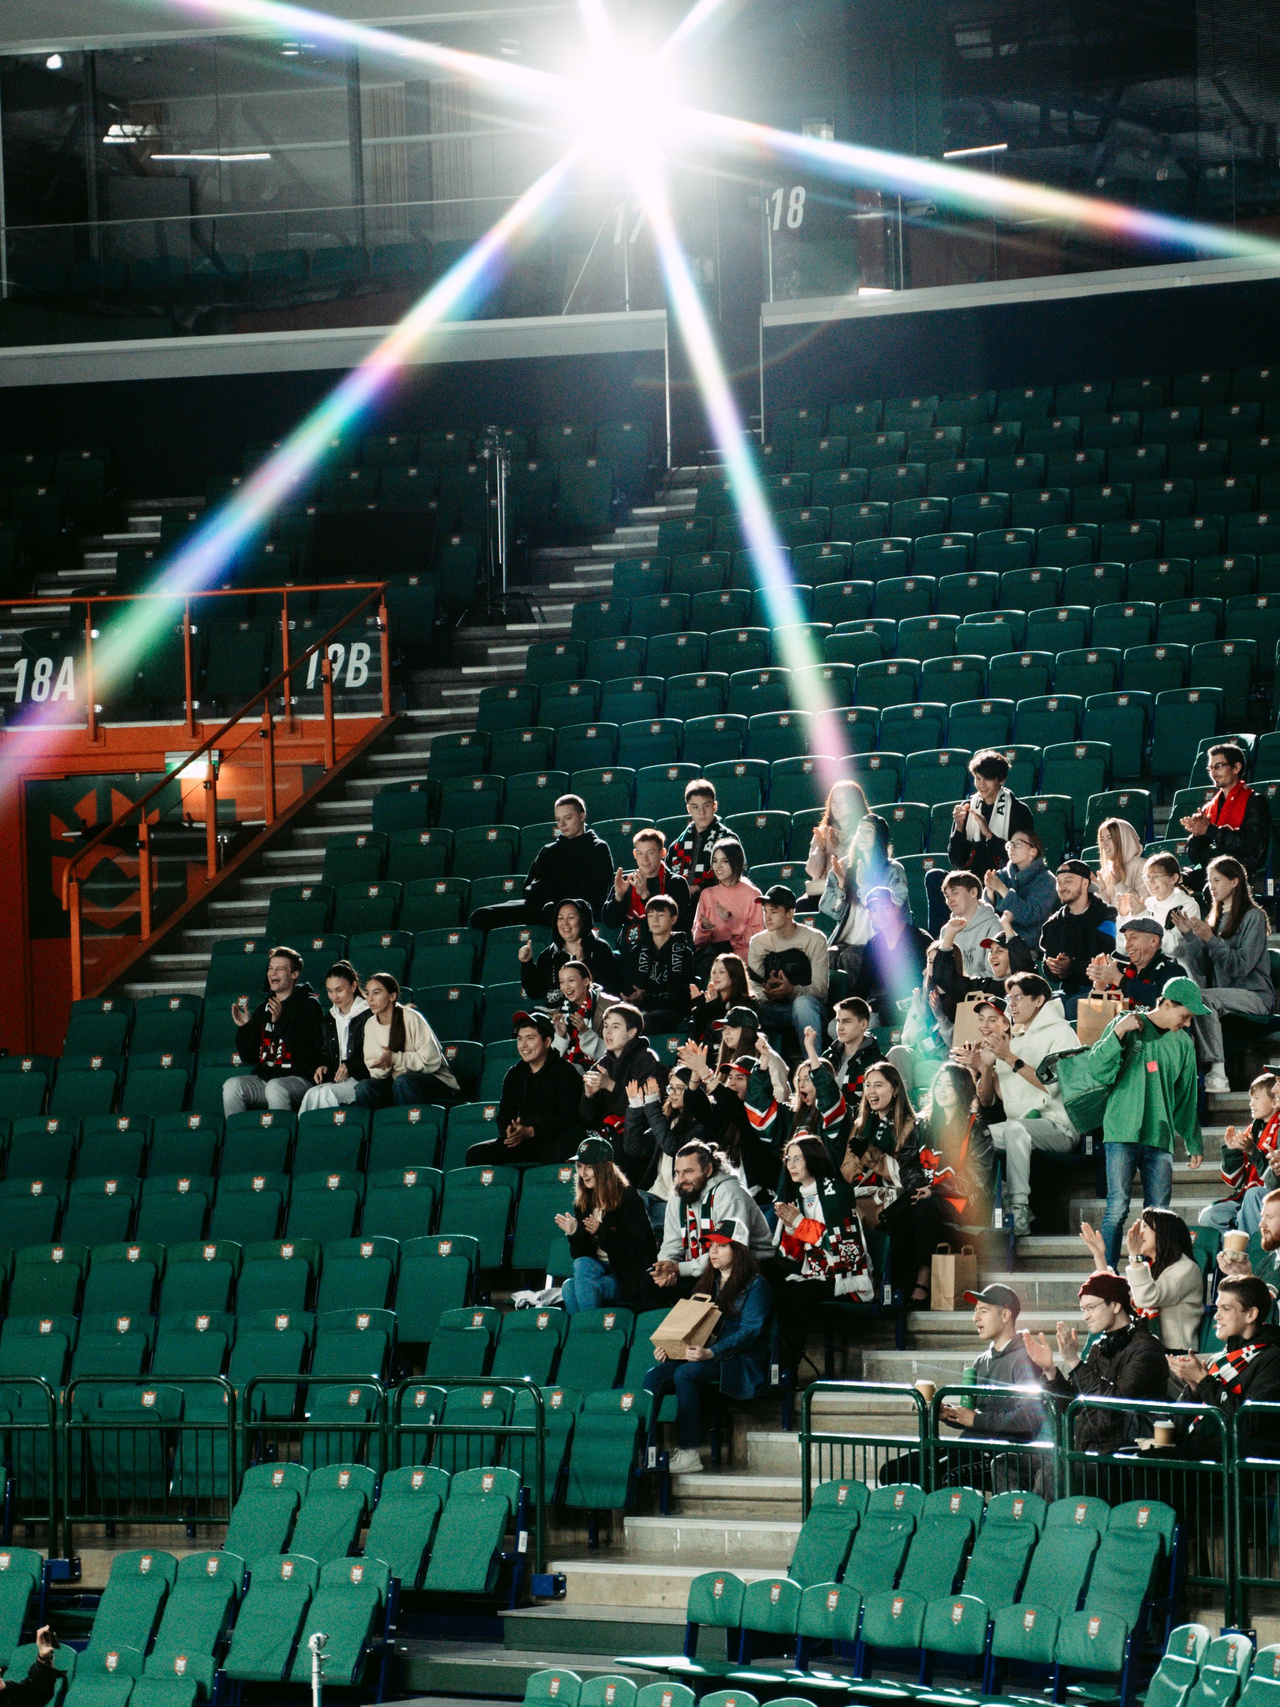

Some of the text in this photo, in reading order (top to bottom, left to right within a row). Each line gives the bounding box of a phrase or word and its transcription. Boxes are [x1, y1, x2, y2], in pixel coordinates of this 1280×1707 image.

[612, 201, 647, 244] 17
[771, 186, 806, 231] 18
[13, 655, 75, 704] 18A
